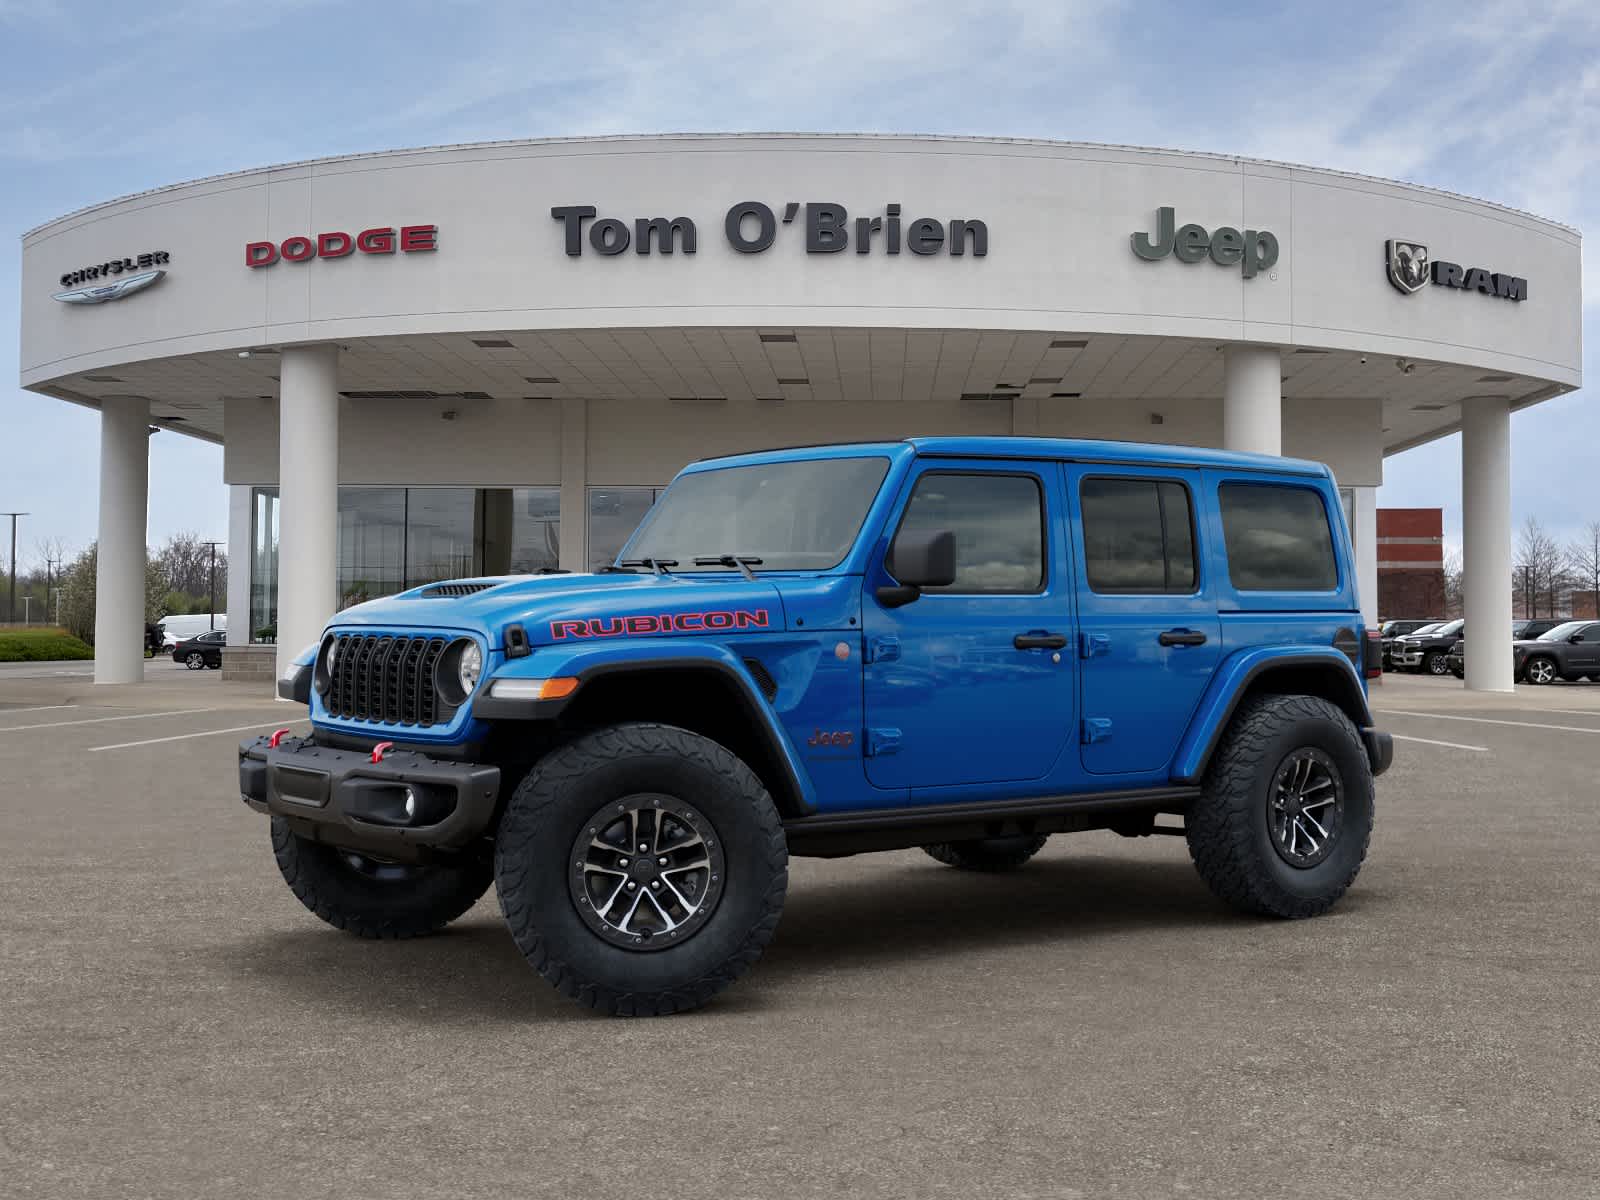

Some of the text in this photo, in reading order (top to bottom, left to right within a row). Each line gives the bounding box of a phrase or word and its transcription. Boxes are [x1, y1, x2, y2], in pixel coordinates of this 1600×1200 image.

[245, 224, 438, 269] DODGE
[551, 205, 697, 257] Tom
[1130, 206, 1280, 279] Jeep
[60, 250, 170, 287] CHRYSLER
[1431, 260, 1528, 302] RAM
[550, 609, 769, 639] RUBICON
[808, 728, 855, 749] Jeep
